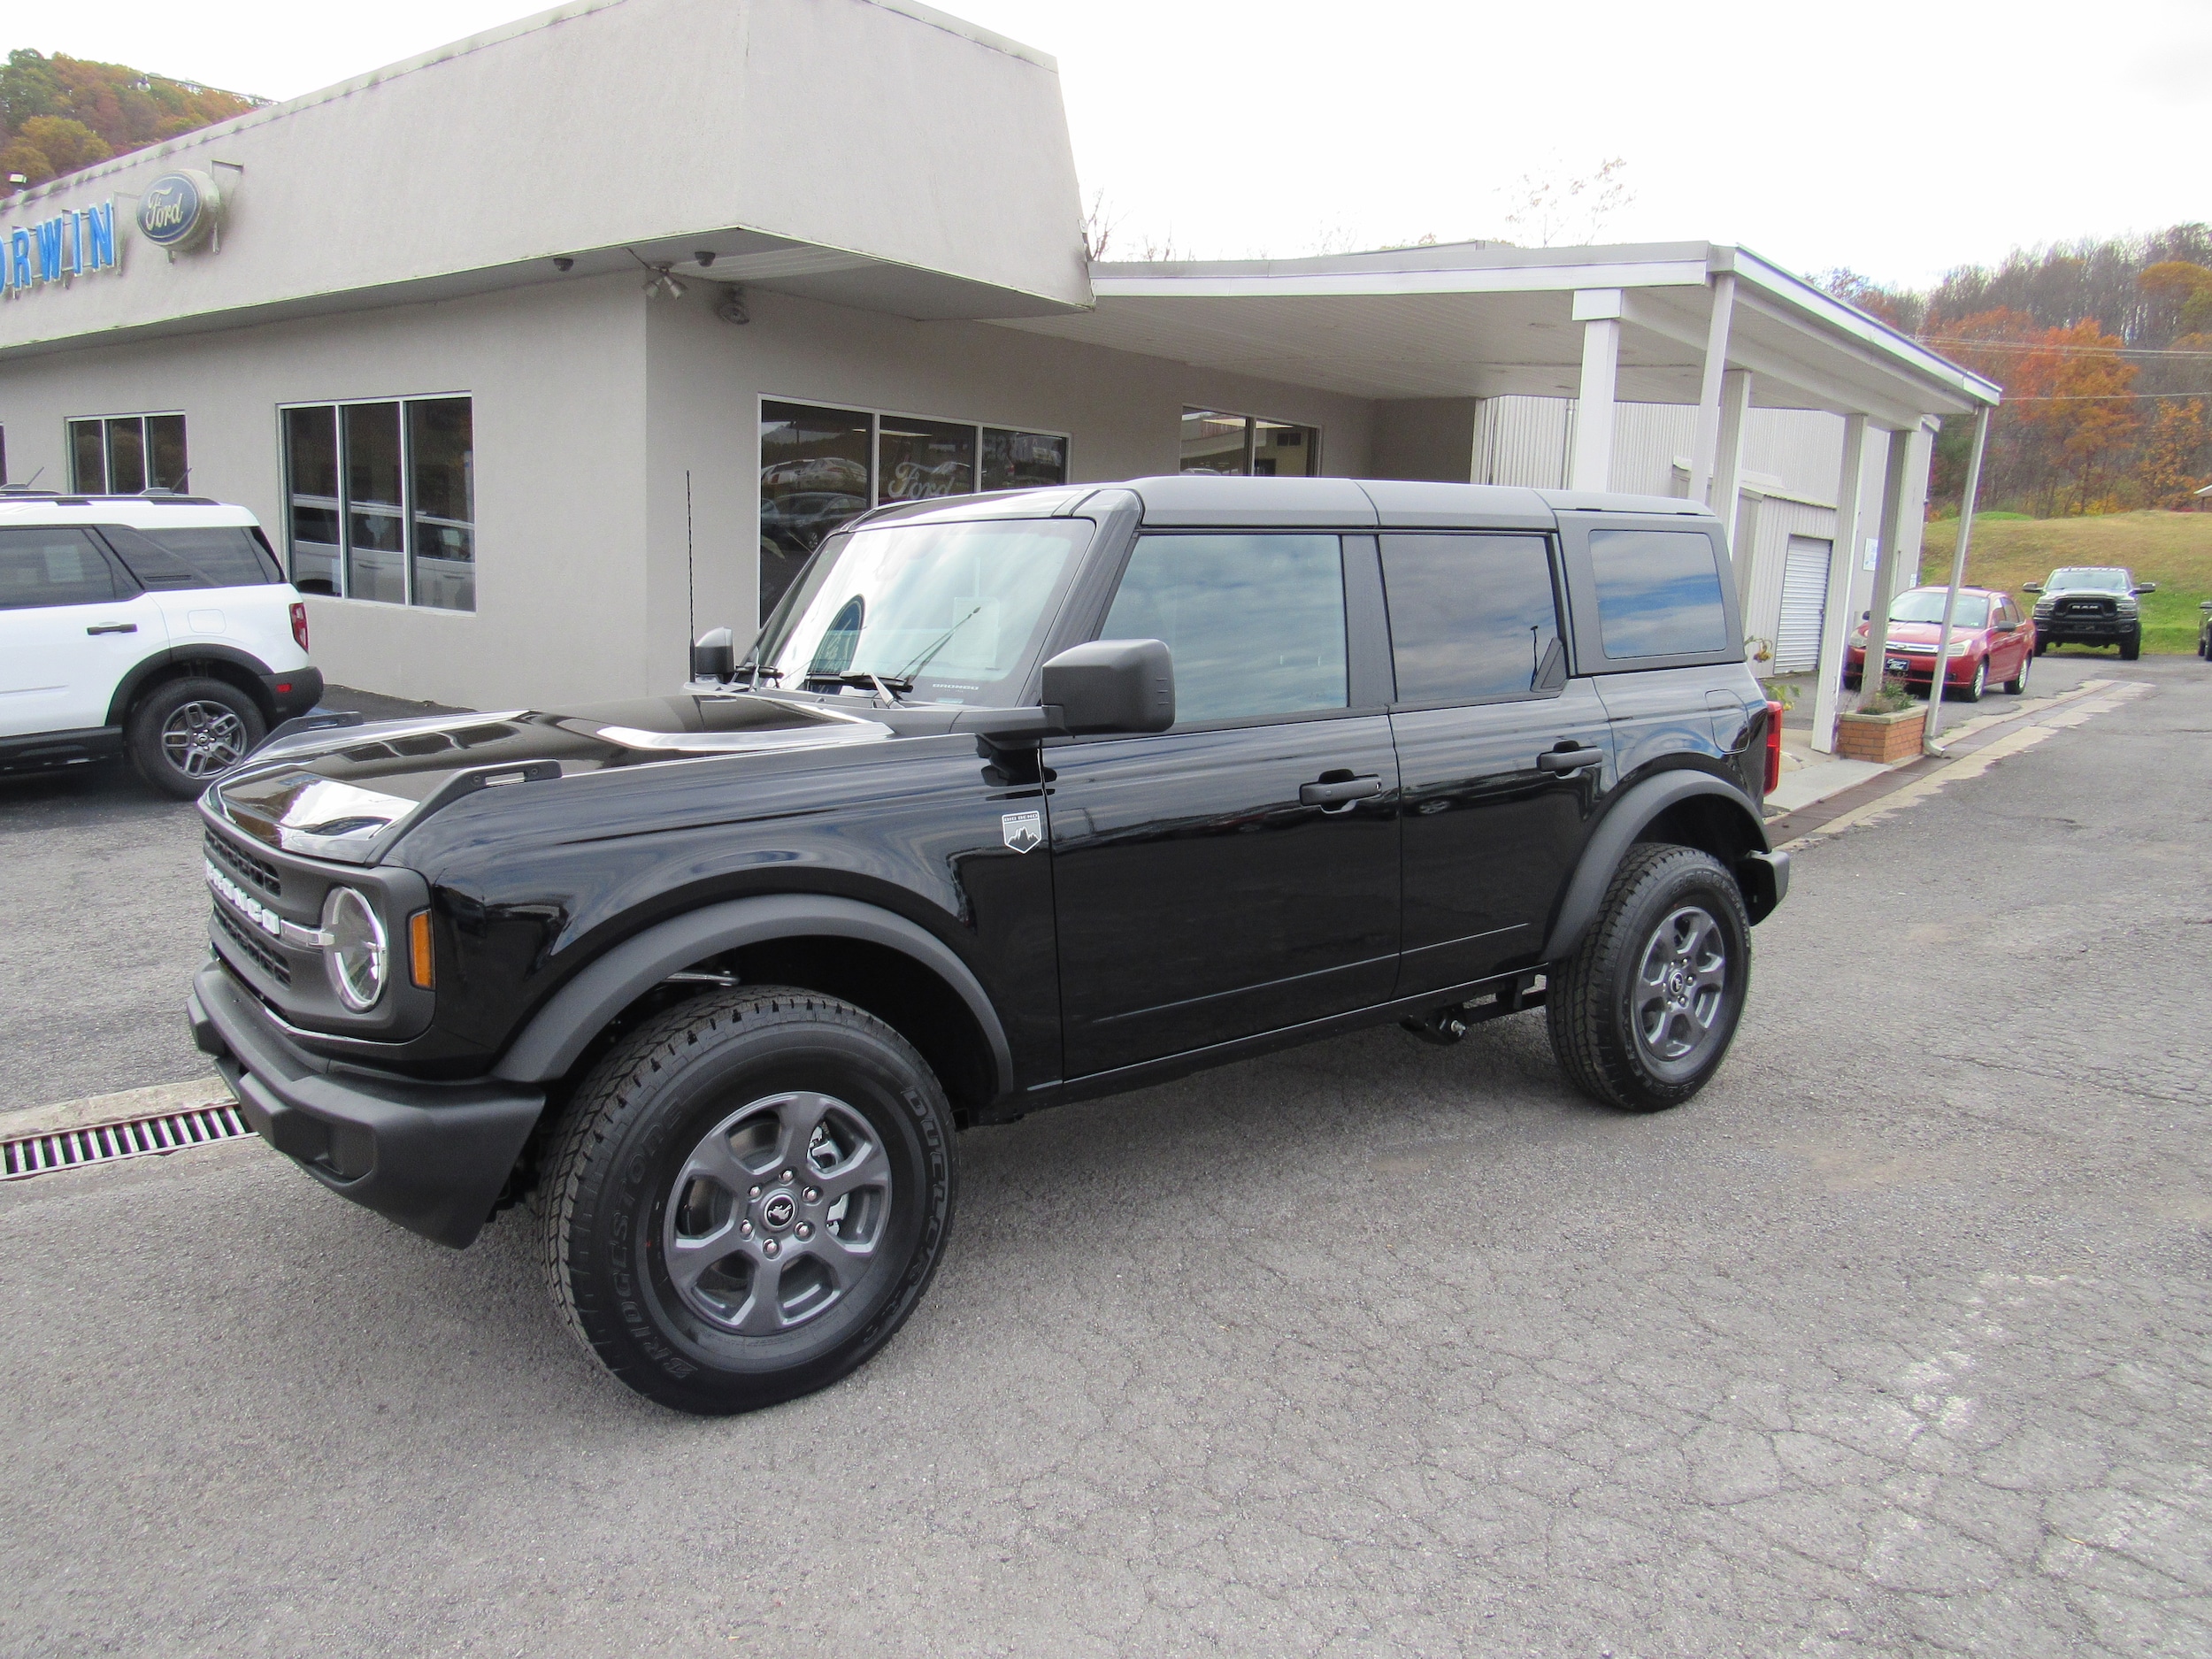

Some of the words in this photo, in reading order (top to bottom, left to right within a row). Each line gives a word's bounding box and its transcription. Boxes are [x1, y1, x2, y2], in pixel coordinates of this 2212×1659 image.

[145, 187, 184, 231] Ford
[0, 198, 115, 296] RWIN
[887, 461, 956, 500] Ford
[610, 1097, 699, 1379] BRIDGESTONE
